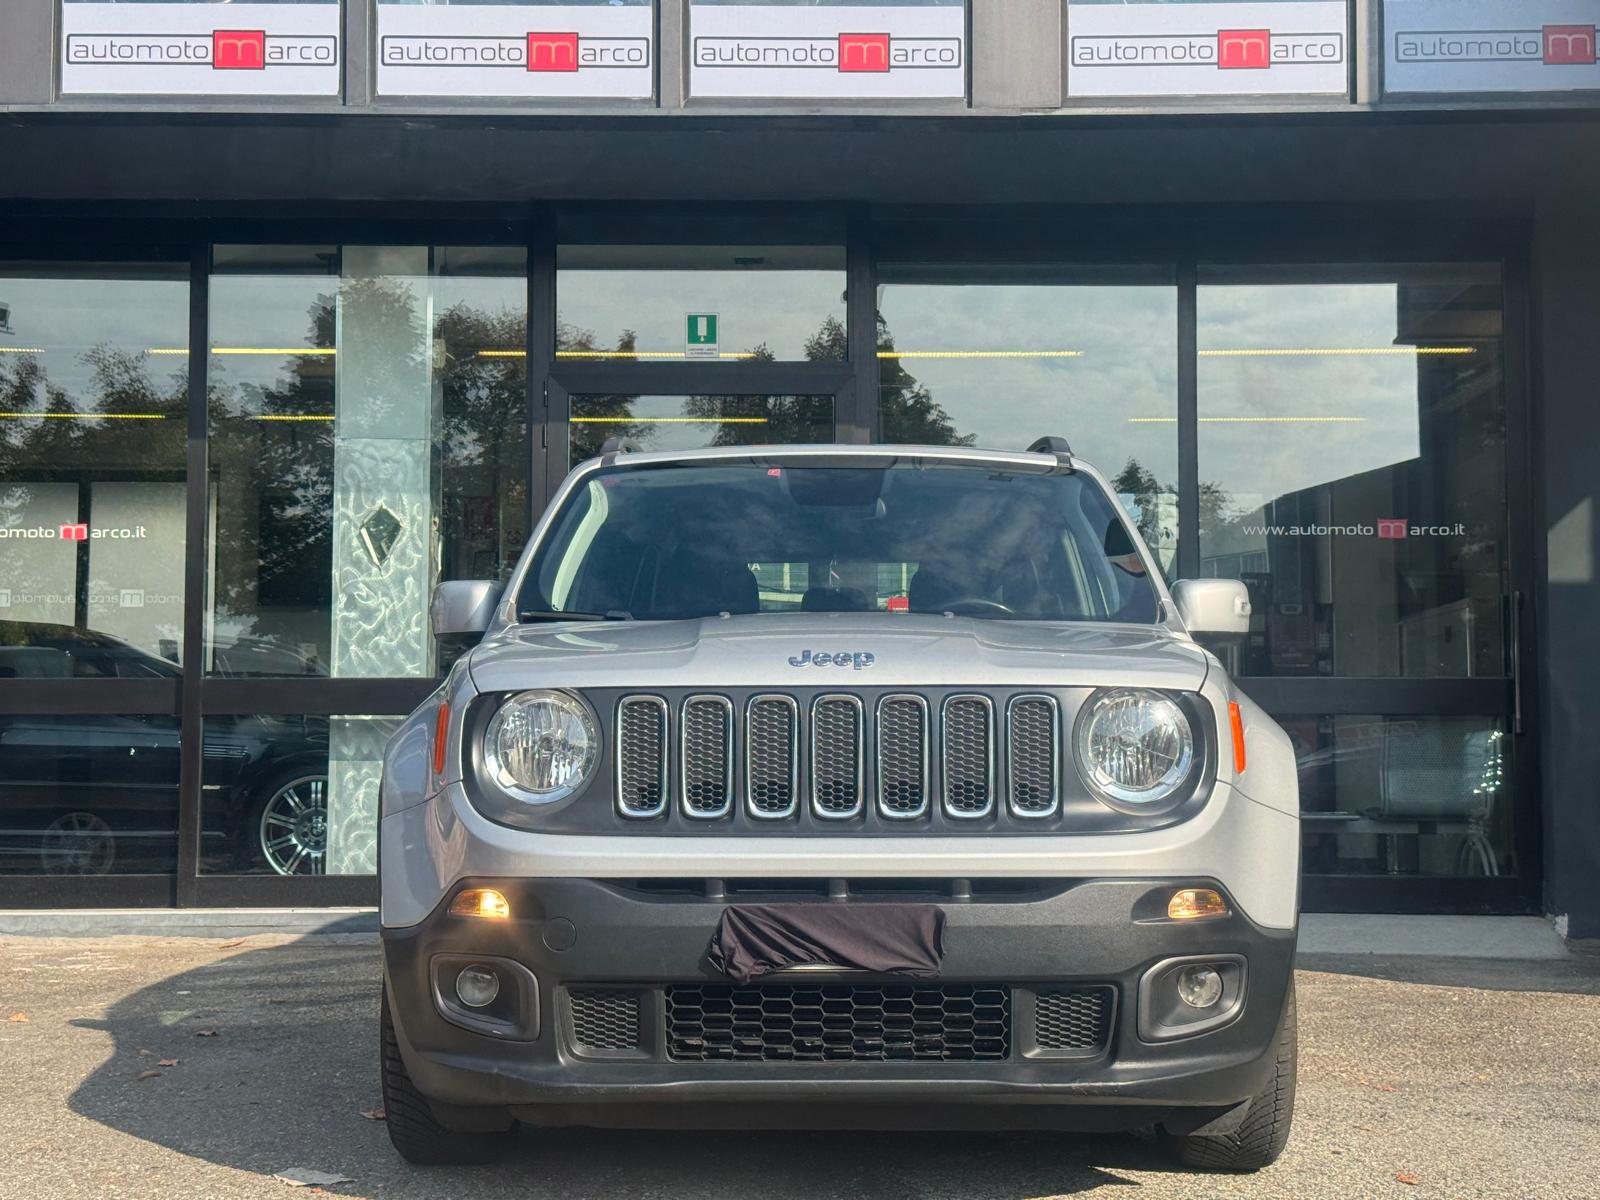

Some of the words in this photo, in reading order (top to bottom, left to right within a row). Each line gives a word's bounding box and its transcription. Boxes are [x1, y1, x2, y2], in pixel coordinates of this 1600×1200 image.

[73, 40, 209, 59] automoto
[388, 42, 523, 62] automoto
[701, 43, 835, 62] automoto
[1078, 41, 1214, 61] automoto
[1402, 36, 1539, 57] automoto
[788, 650, 875, 670] Jeep
